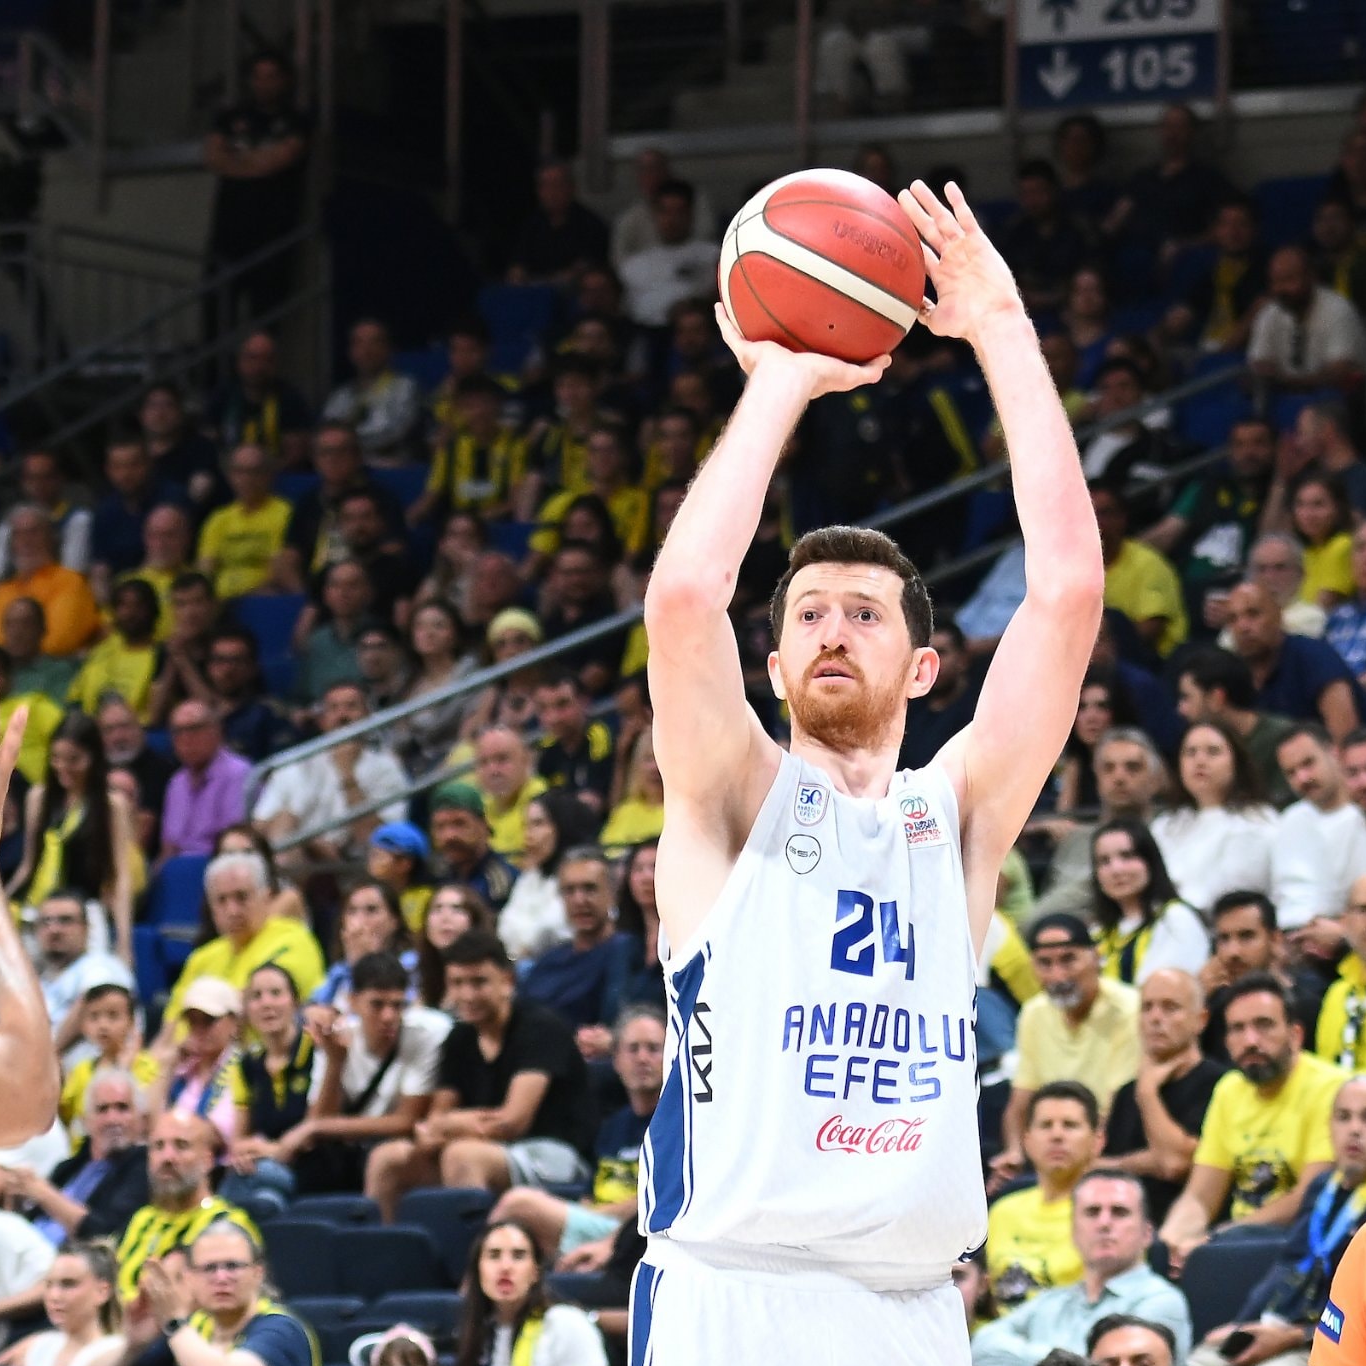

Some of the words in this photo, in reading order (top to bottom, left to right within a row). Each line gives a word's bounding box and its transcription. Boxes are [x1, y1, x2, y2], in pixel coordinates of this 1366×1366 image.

[1101, 46, 1197, 90] 105
[830, 889, 916, 981] 24
[782, 1002, 966, 1062] ANADOLU
[804, 1054, 941, 1104] EFES
